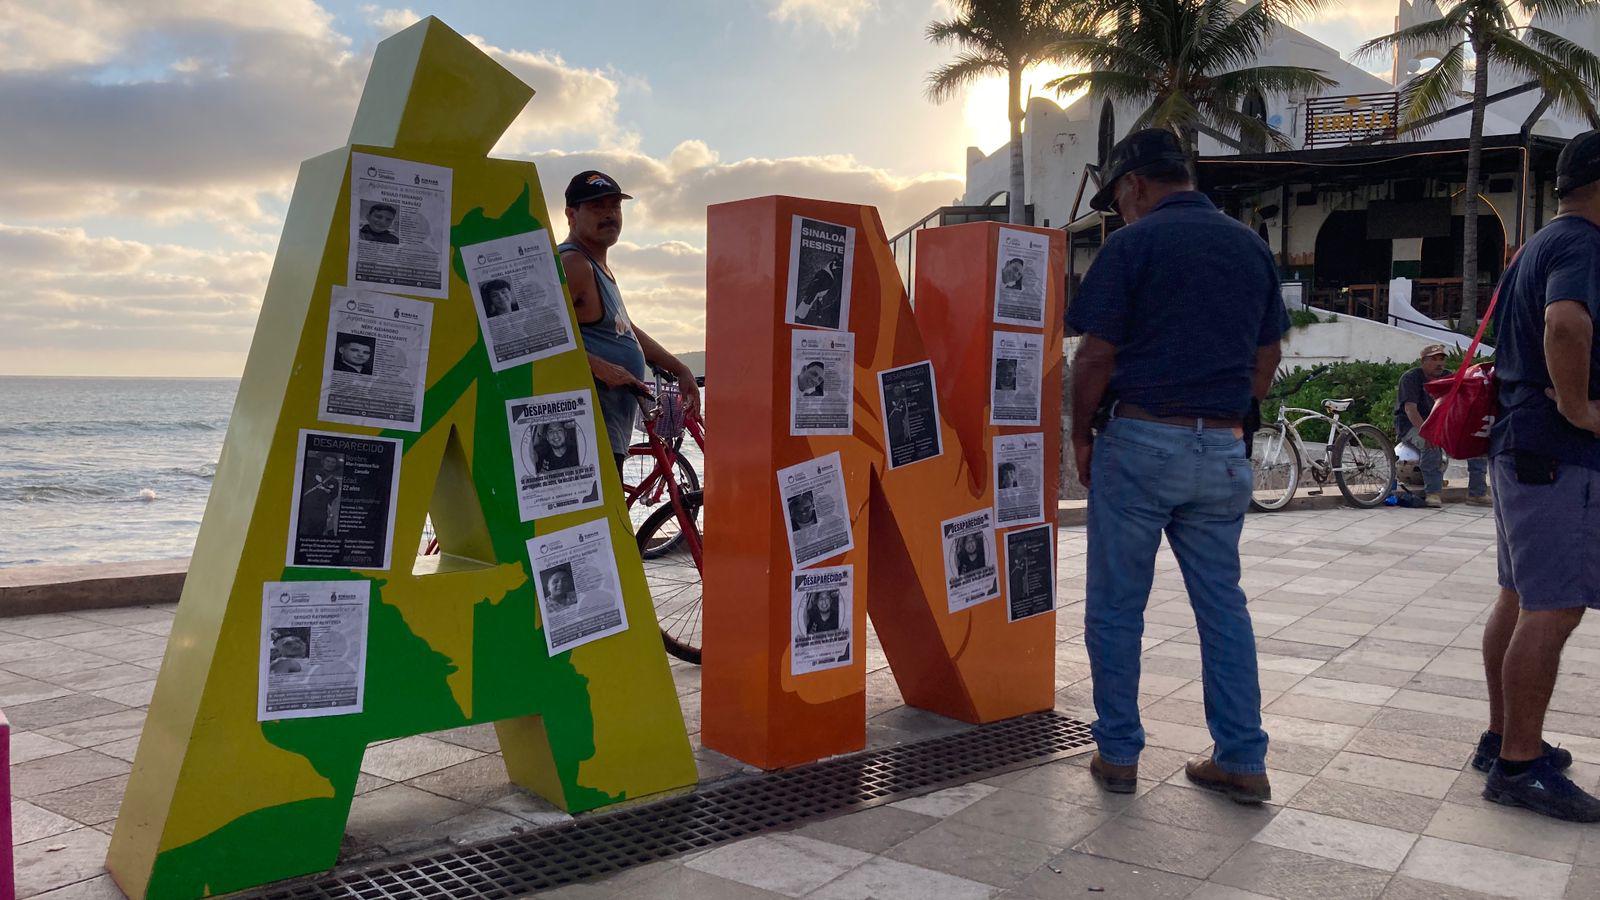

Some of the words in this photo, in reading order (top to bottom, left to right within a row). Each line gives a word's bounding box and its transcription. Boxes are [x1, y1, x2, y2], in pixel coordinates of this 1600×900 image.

[1312, 112, 1391, 131] TERRAZA
[802, 227, 846, 243] SINALOA
[802, 239, 844, 254] RESISTE
[523, 400, 577, 417] DESAPARECIDO
[313, 437, 384, 453] DESAPARECIDO
[951, 515, 984, 533] DESAPARECIDO
[803, 573, 842, 586] DESAPARECIDO
